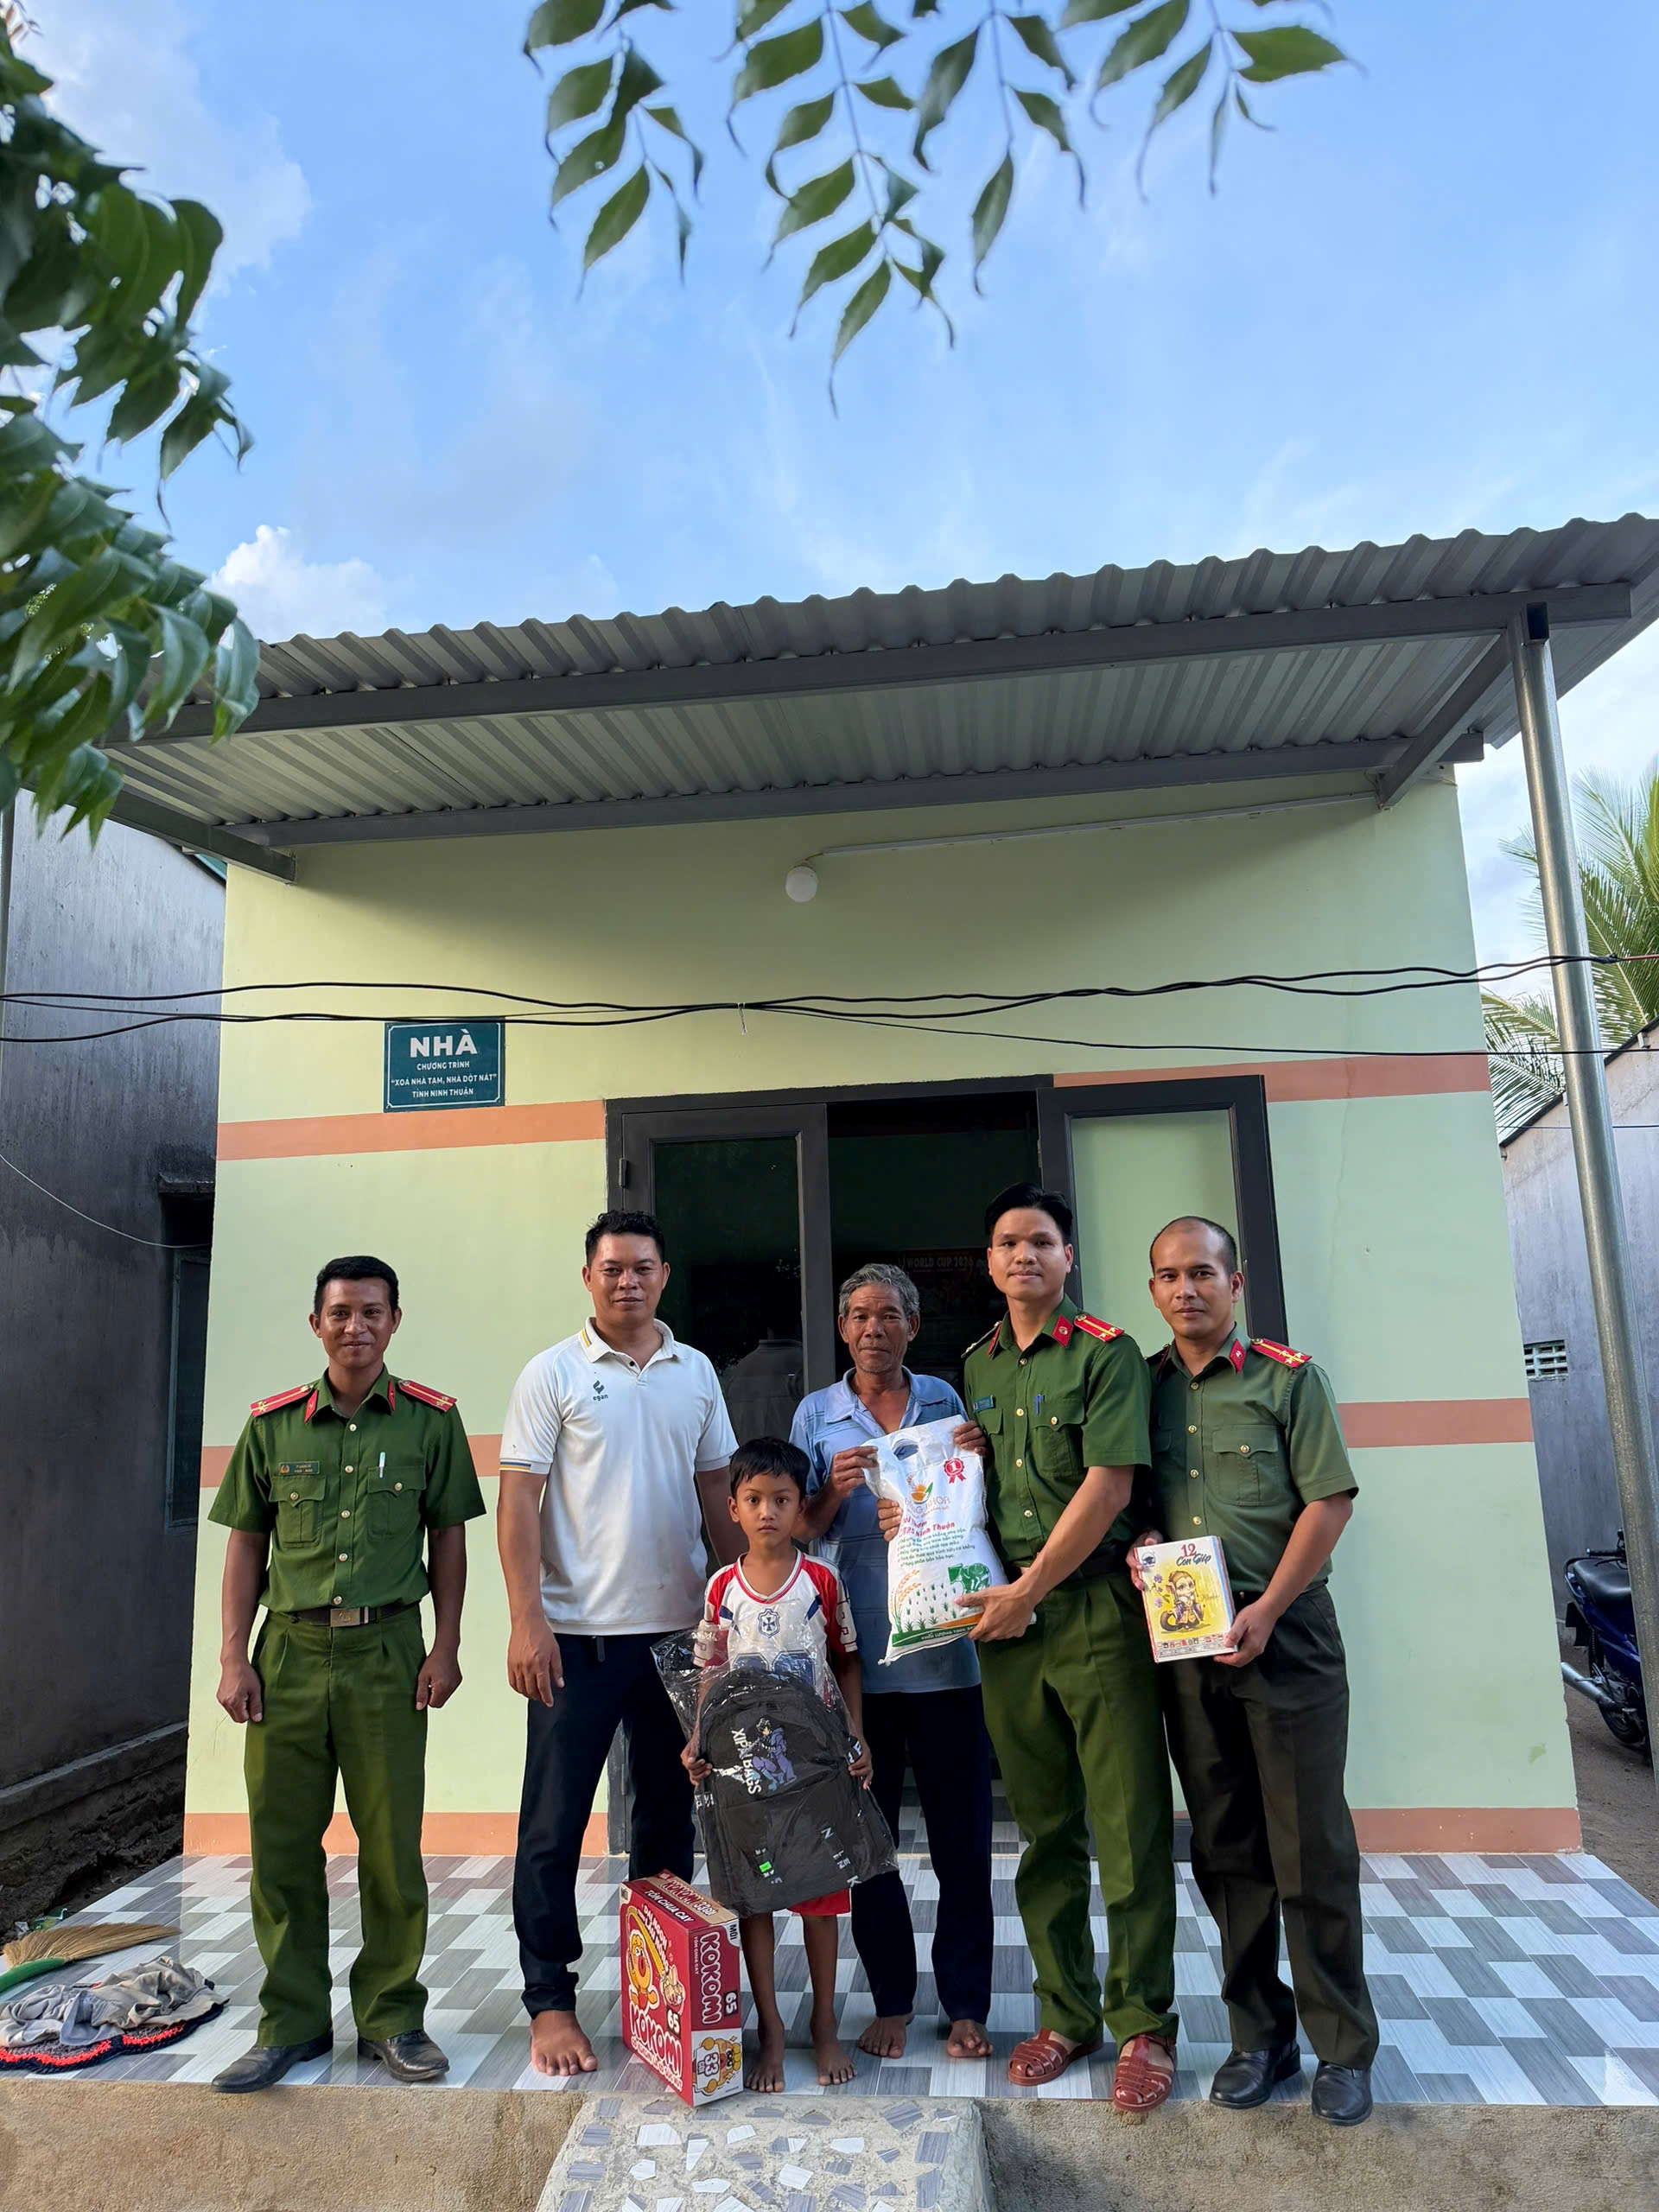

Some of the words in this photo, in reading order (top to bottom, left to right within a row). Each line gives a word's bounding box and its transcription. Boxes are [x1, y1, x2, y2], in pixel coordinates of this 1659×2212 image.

[410, 1029, 477, 1058] NHÀ
[416, 1062, 447, 1071] CHƯƠNG
[448, 1060, 470, 1070] TRÌNH
[430, 1088, 448, 1096] NINH
[449, 1086, 474, 1096] THUẬN
[906, 1257, 934, 1268] WORLD
[937, 1257, 952, 1267] CUP
[1176, 1555, 1192, 1567] Con
[1181, 1542, 1197, 1558] 12
[660, 1879, 704, 1905] KOKOMI
[645, 1889, 662, 1901] TÔM
[658, 1897, 679, 1913] CHUA
[675, 1910, 696, 1923] CAY
[700, 1931, 722, 2024] KOKOMI
[725, 1992, 738, 2014] 65
[667, 2009, 680, 2035] 65
[630, 2000, 683, 2079] KOKOMI
[705, 2051, 720, 2077] 33
